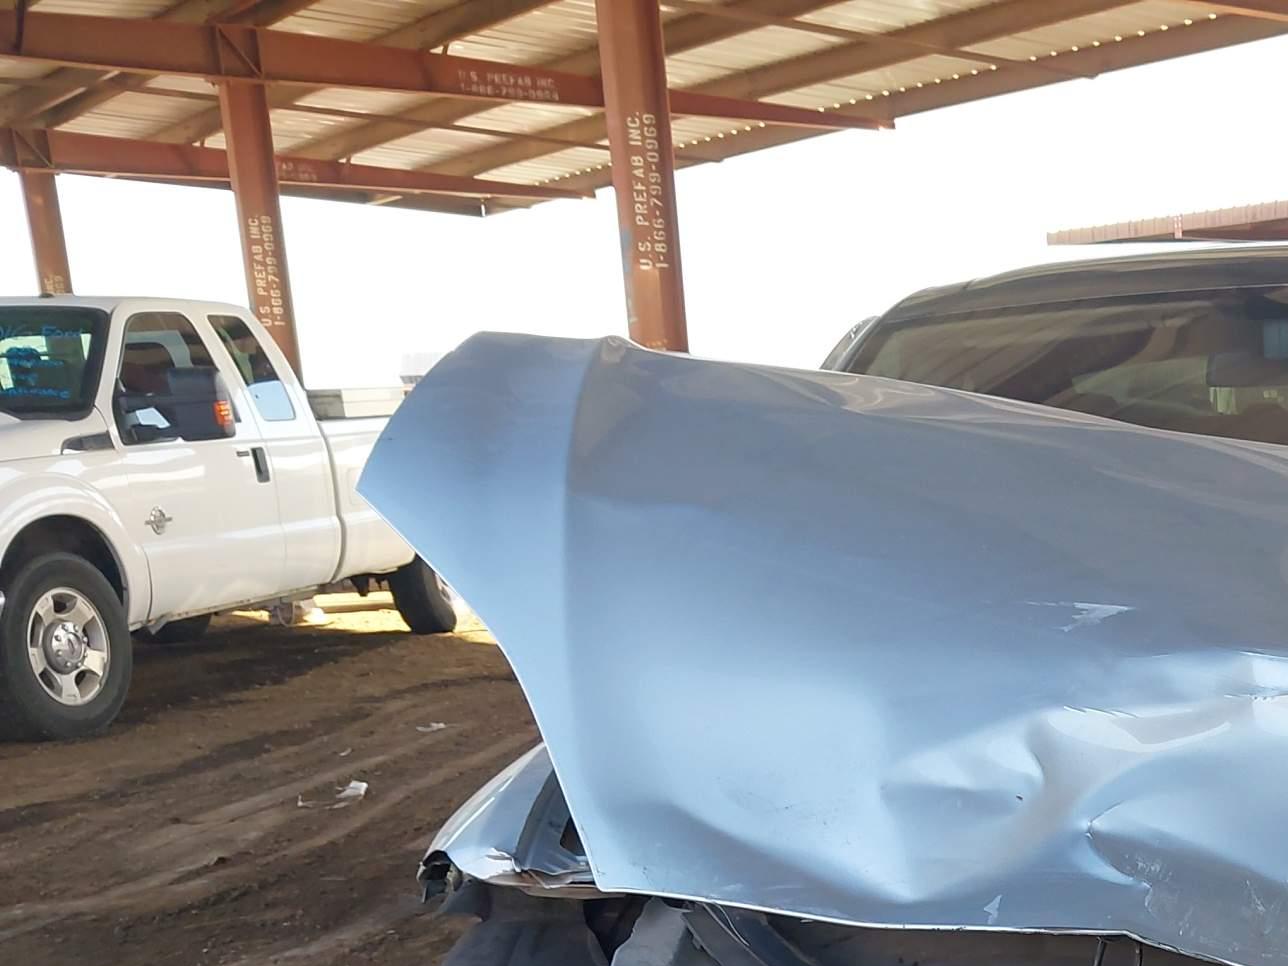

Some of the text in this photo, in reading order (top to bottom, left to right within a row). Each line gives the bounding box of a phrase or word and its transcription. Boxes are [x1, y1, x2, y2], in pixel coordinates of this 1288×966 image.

[626, 111, 653, 271] U.S. PREFAB INC.
[642, 113, 670, 269] 1-866-799-0969
[252, 245, 268, 296] PREFAB
